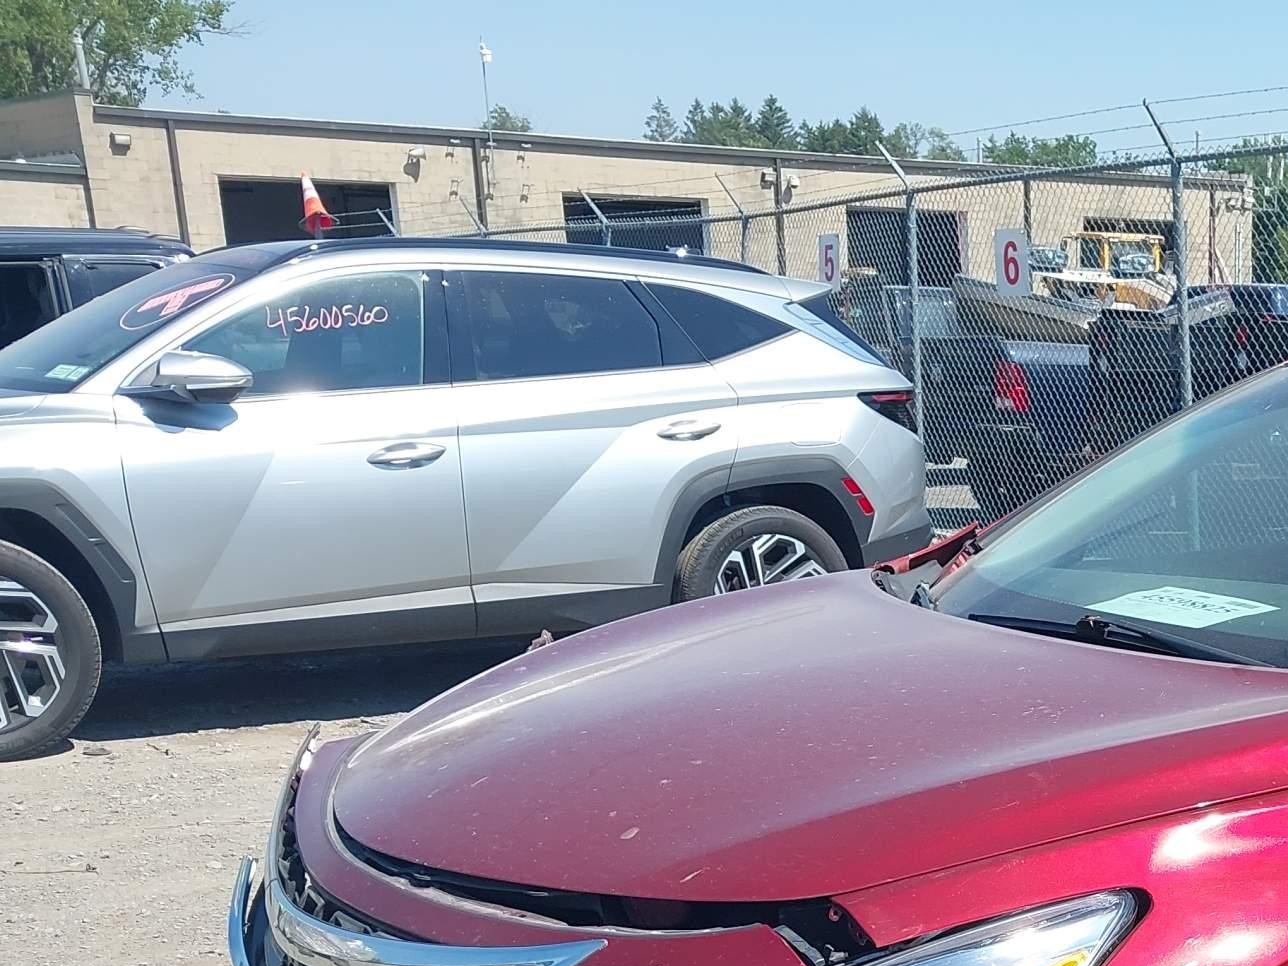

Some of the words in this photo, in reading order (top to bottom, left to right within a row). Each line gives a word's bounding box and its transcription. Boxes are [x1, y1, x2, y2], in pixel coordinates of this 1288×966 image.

[823, 243, 835, 282] 5
[1002, 240, 1020, 286] 6
[266, 304, 389, 337] 45600560
